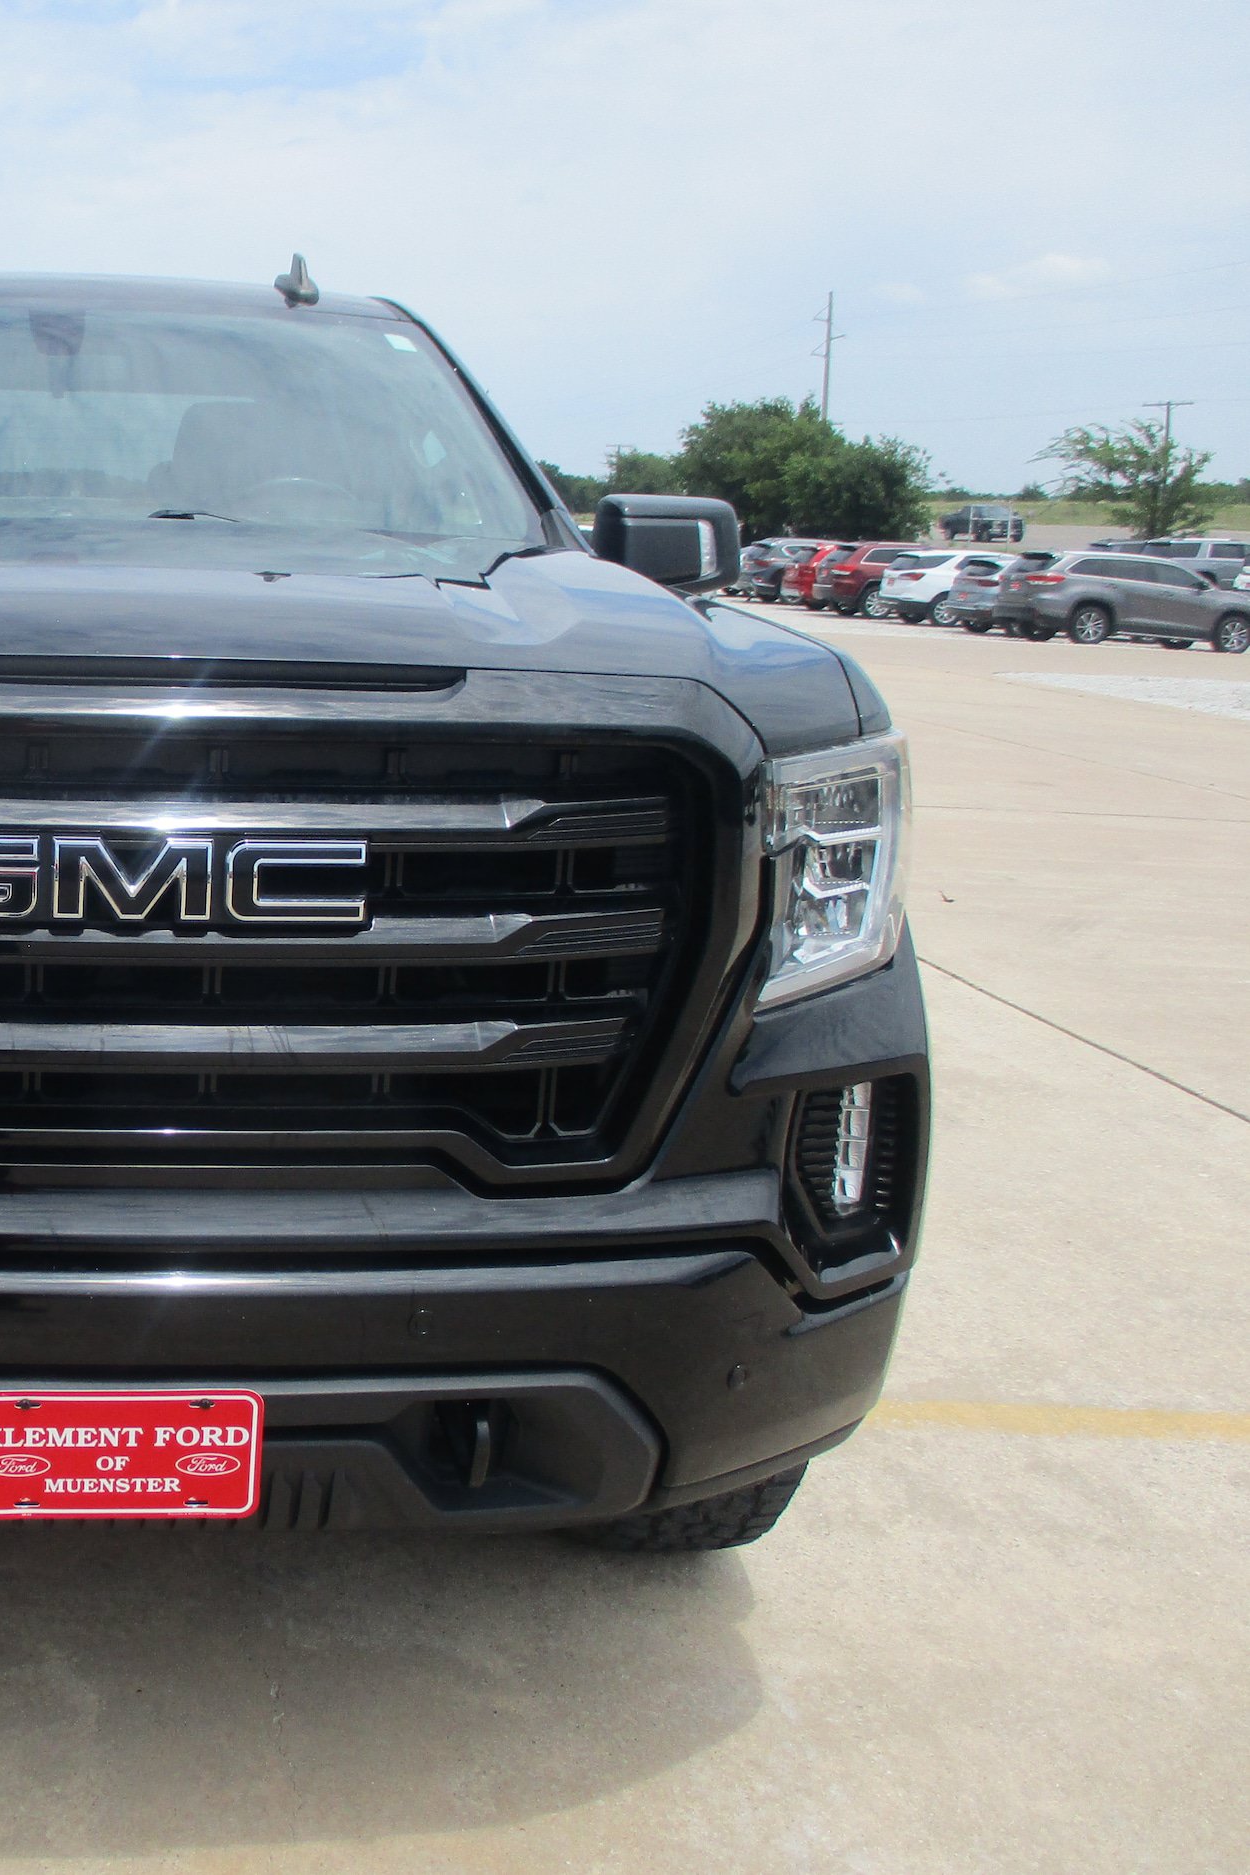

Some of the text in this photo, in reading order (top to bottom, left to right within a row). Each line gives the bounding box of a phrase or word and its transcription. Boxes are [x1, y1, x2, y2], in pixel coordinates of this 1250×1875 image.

[153, 1425, 250, 1447] FORD
[95, 1455, 130, 1471] OF
[186, 1456, 228, 1473] Ford
[43, 1477, 182, 1494] MUENSTER
